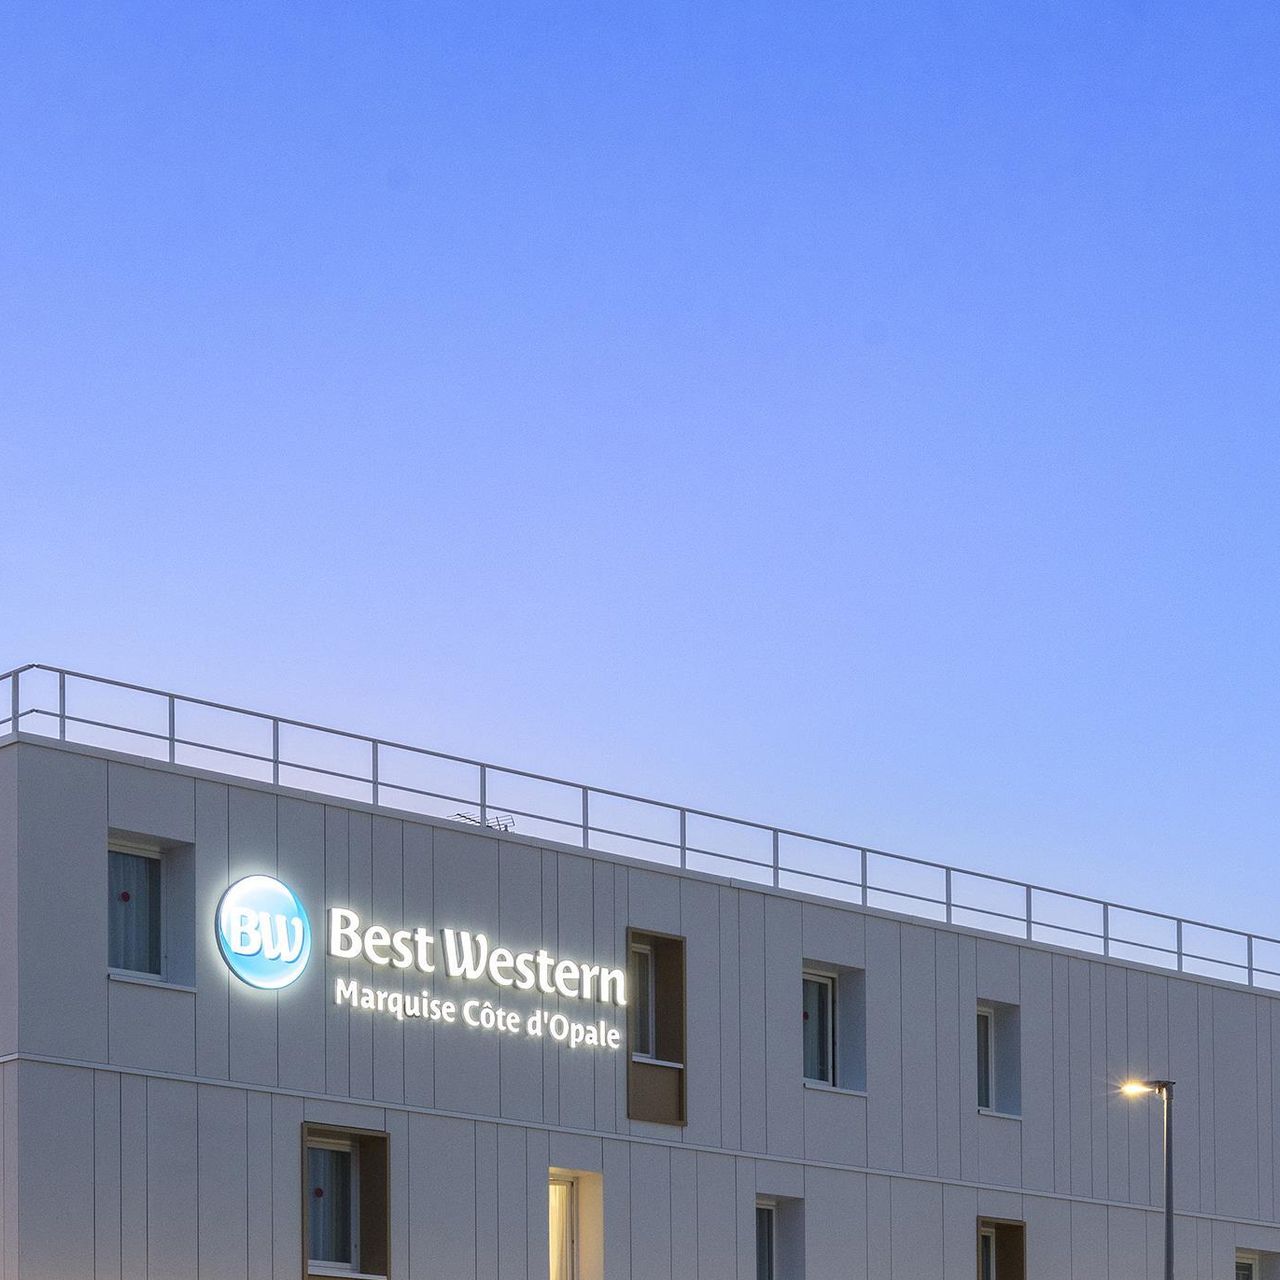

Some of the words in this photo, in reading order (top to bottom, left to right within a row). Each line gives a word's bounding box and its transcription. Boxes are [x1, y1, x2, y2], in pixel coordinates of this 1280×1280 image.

[230, 906, 303, 963] BW
[329, 907, 436, 973] Best
[440, 927, 627, 1005] Western
[334, 979, 456, 1022] Marquise
[462, 999, 521, 1033] Côte
[526, 1013, 621, 1049] d'Opale
